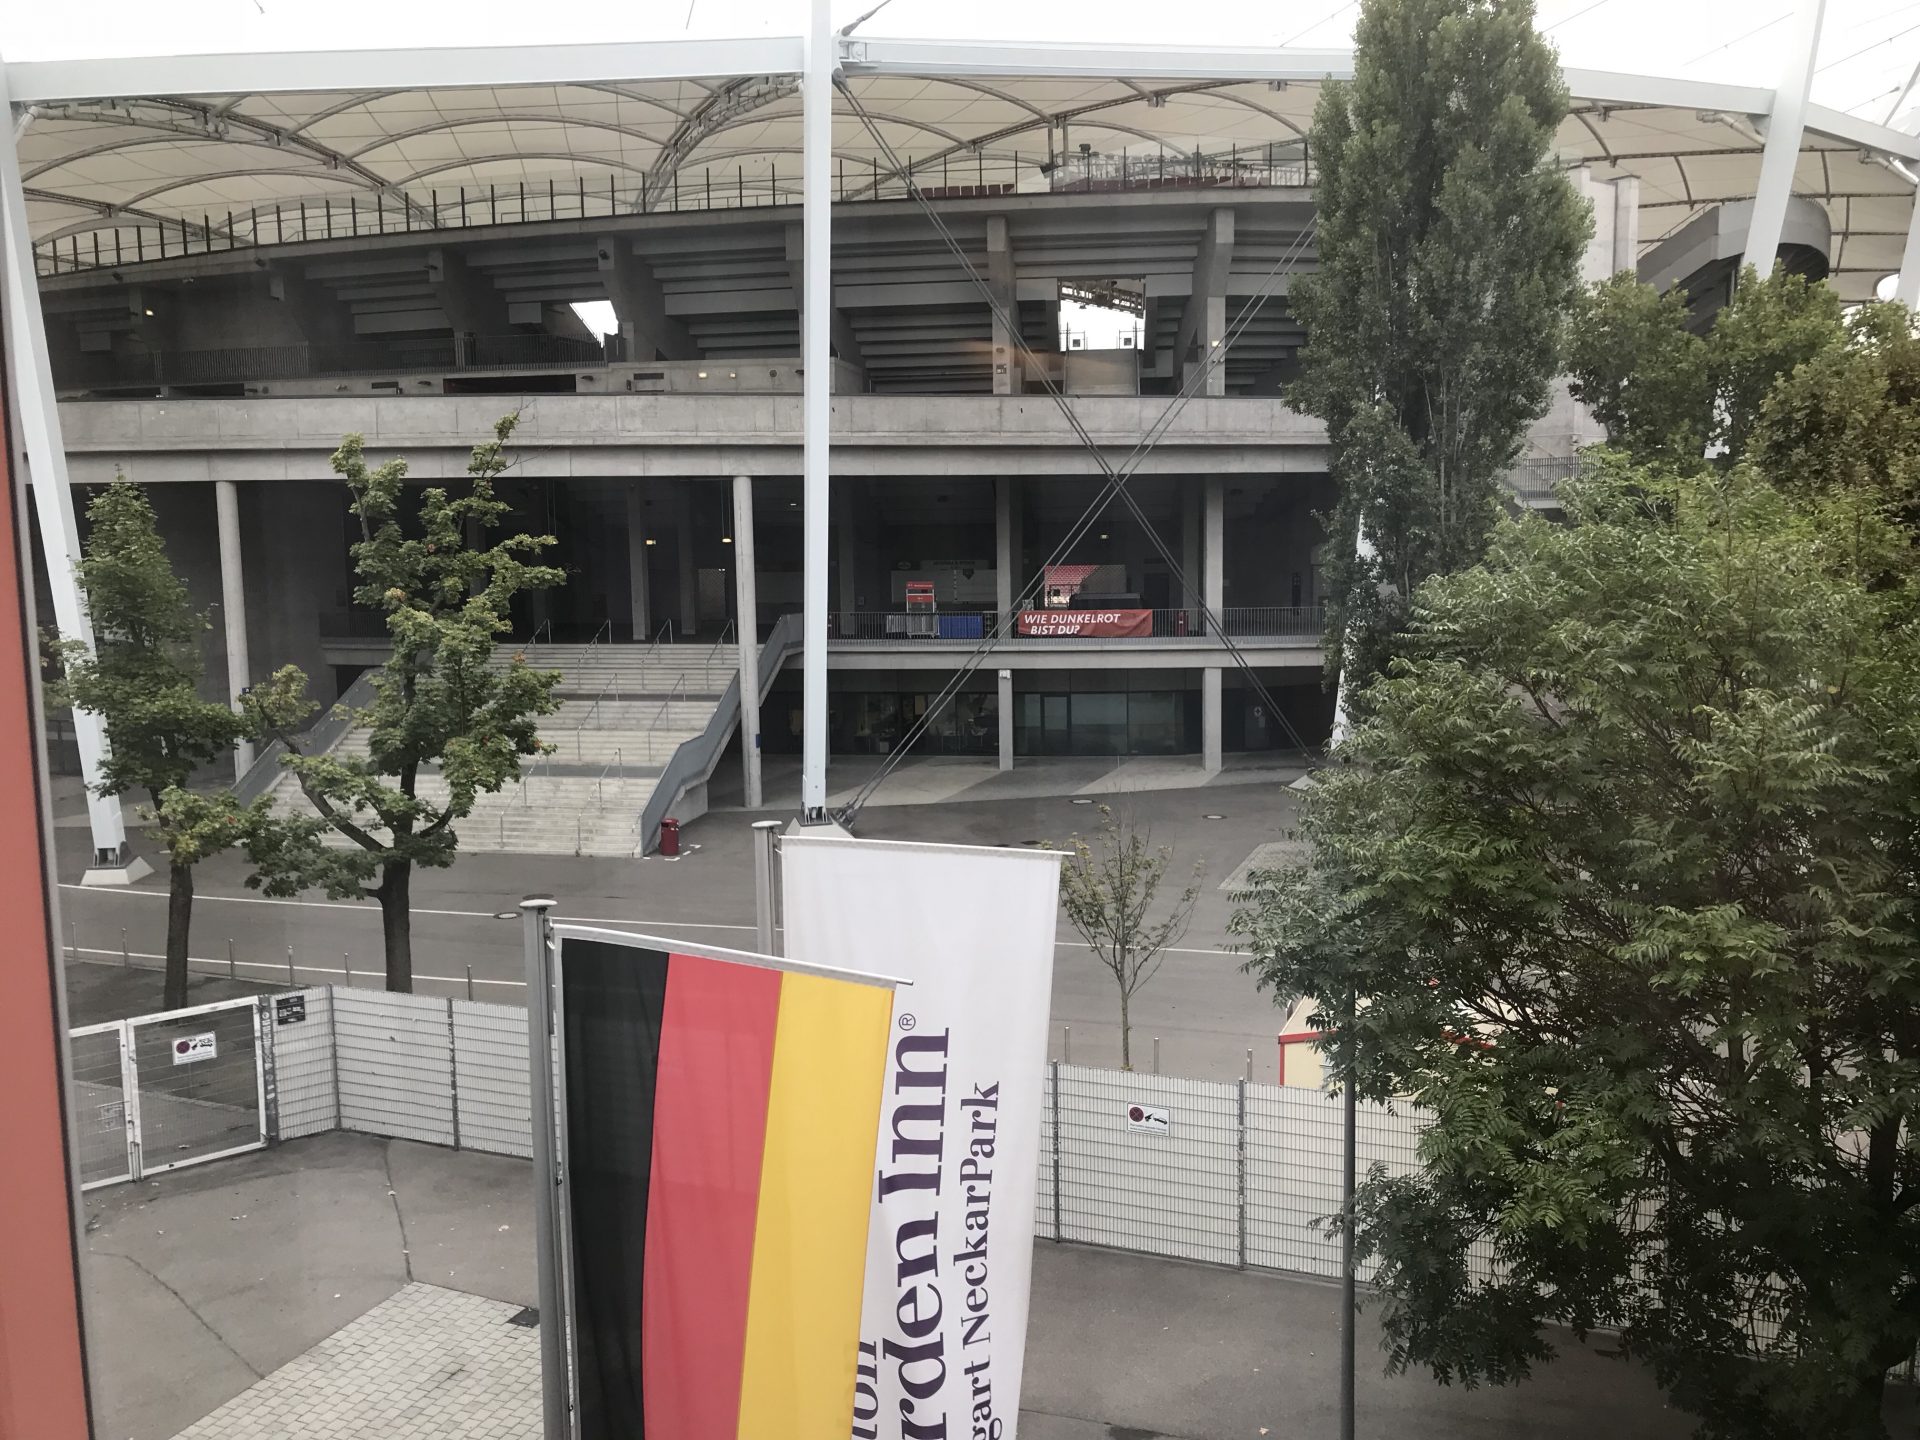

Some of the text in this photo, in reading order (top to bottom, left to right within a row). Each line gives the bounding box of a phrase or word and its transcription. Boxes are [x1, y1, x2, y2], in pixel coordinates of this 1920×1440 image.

[1024, 613, 1121, 624] WIE DUNKELROT
[1030, 625, 1080, 635] BIST DU?
[954, 1081, 999, 1351] NeckarPark
